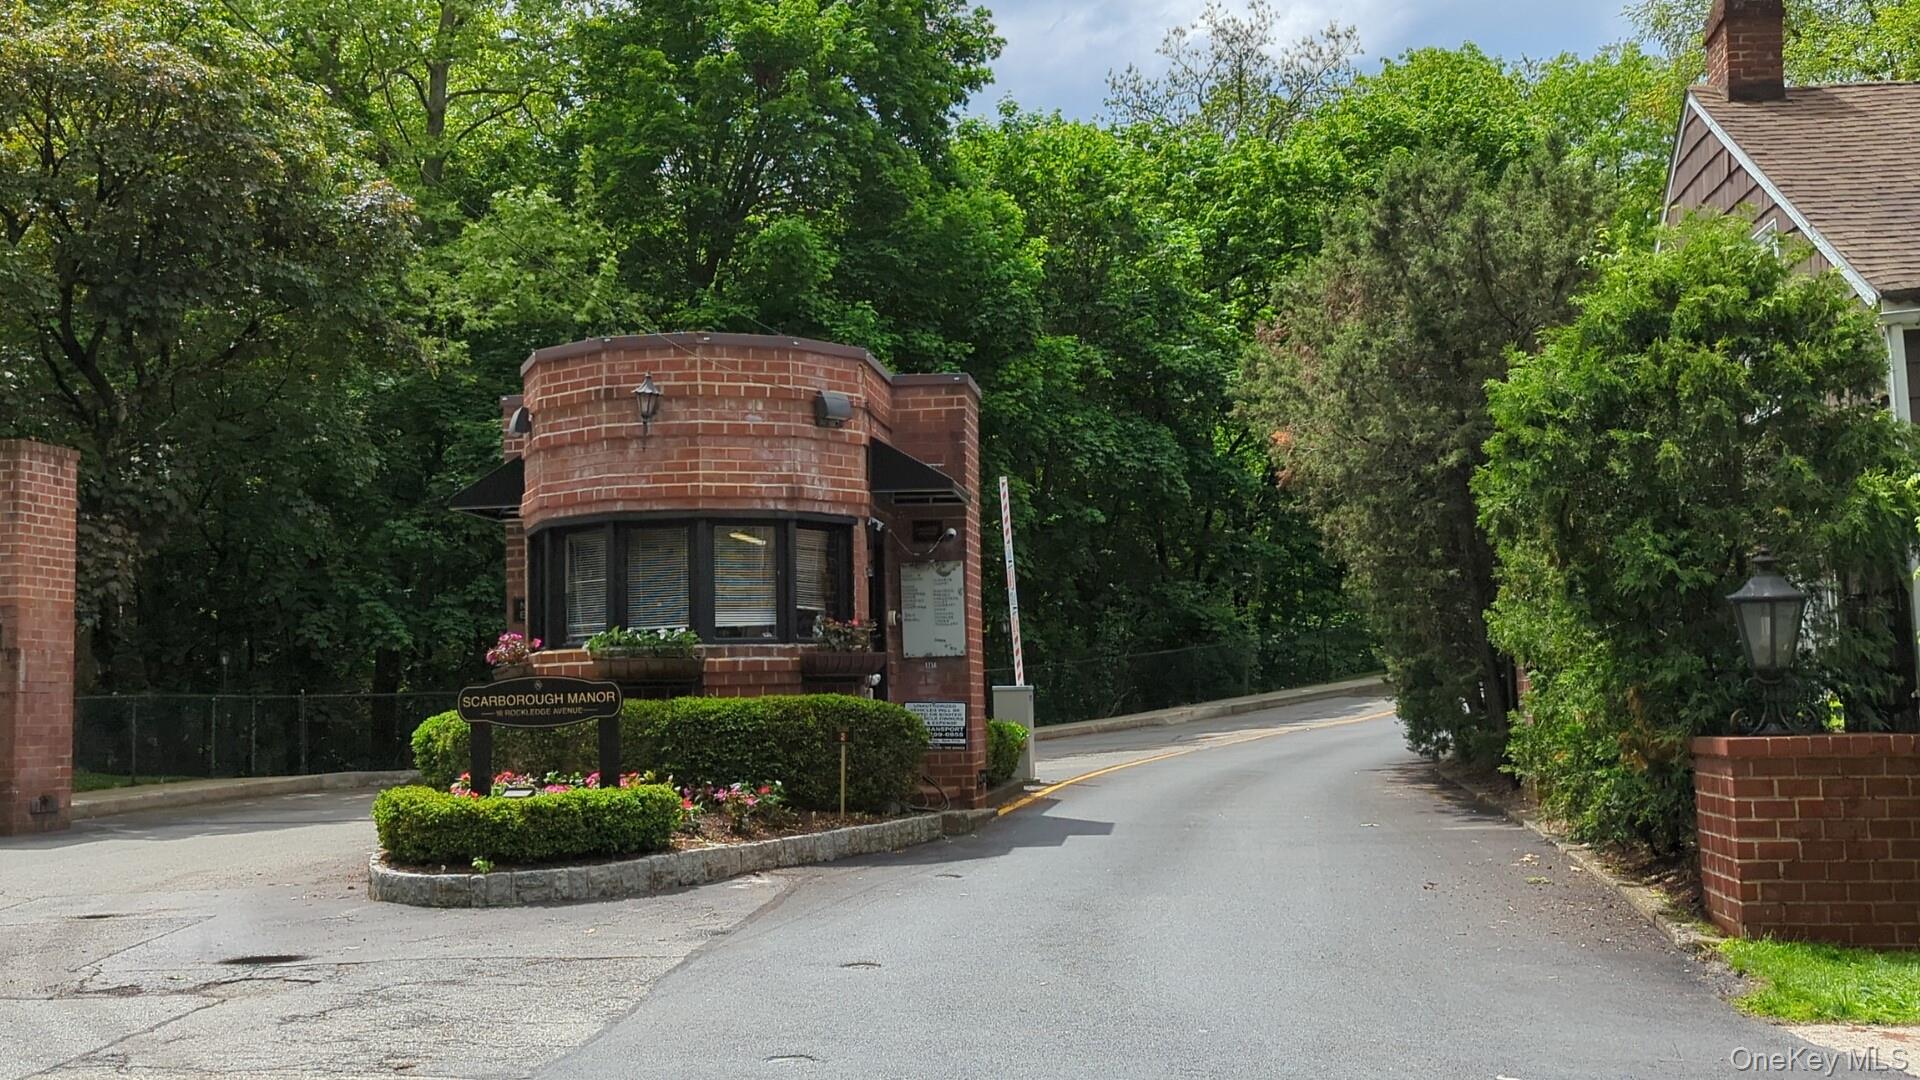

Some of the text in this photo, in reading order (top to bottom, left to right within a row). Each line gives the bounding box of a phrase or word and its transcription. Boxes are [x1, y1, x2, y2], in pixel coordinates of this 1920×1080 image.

[462, 691, 616, 708] SCARBOROUGH MANOR
[504, 708, 551, 717] ROCKLEDGE
[553, 706, 583, 715] AVENUE
